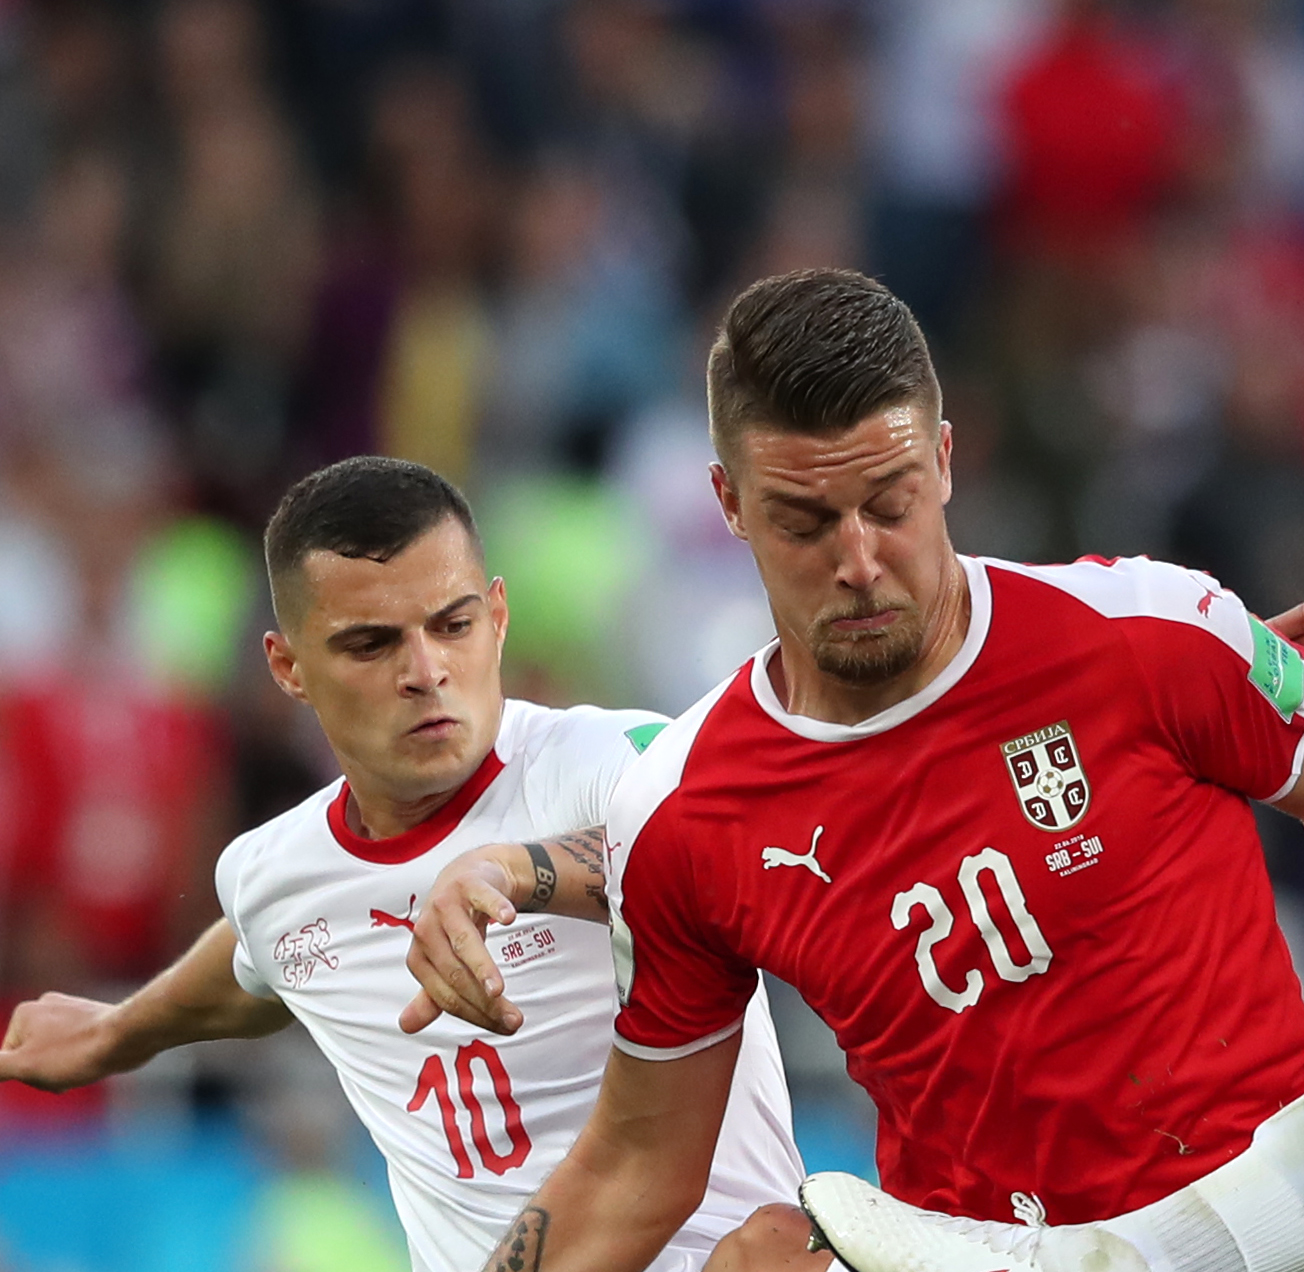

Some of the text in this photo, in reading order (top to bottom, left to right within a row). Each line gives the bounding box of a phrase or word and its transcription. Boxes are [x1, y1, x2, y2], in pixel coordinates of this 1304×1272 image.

[1004, 724, 1066, 754] СРБИЈА
[1045, 849, 1072, 872] SRB
[1080, 835, 1104, 858] SUI
[501, 941, 525, 963] SRB
[533, 928, 556, 949] SUI
[891, 847, 1053, 1014] 20
[407, 1039, 533, 1179] 10
